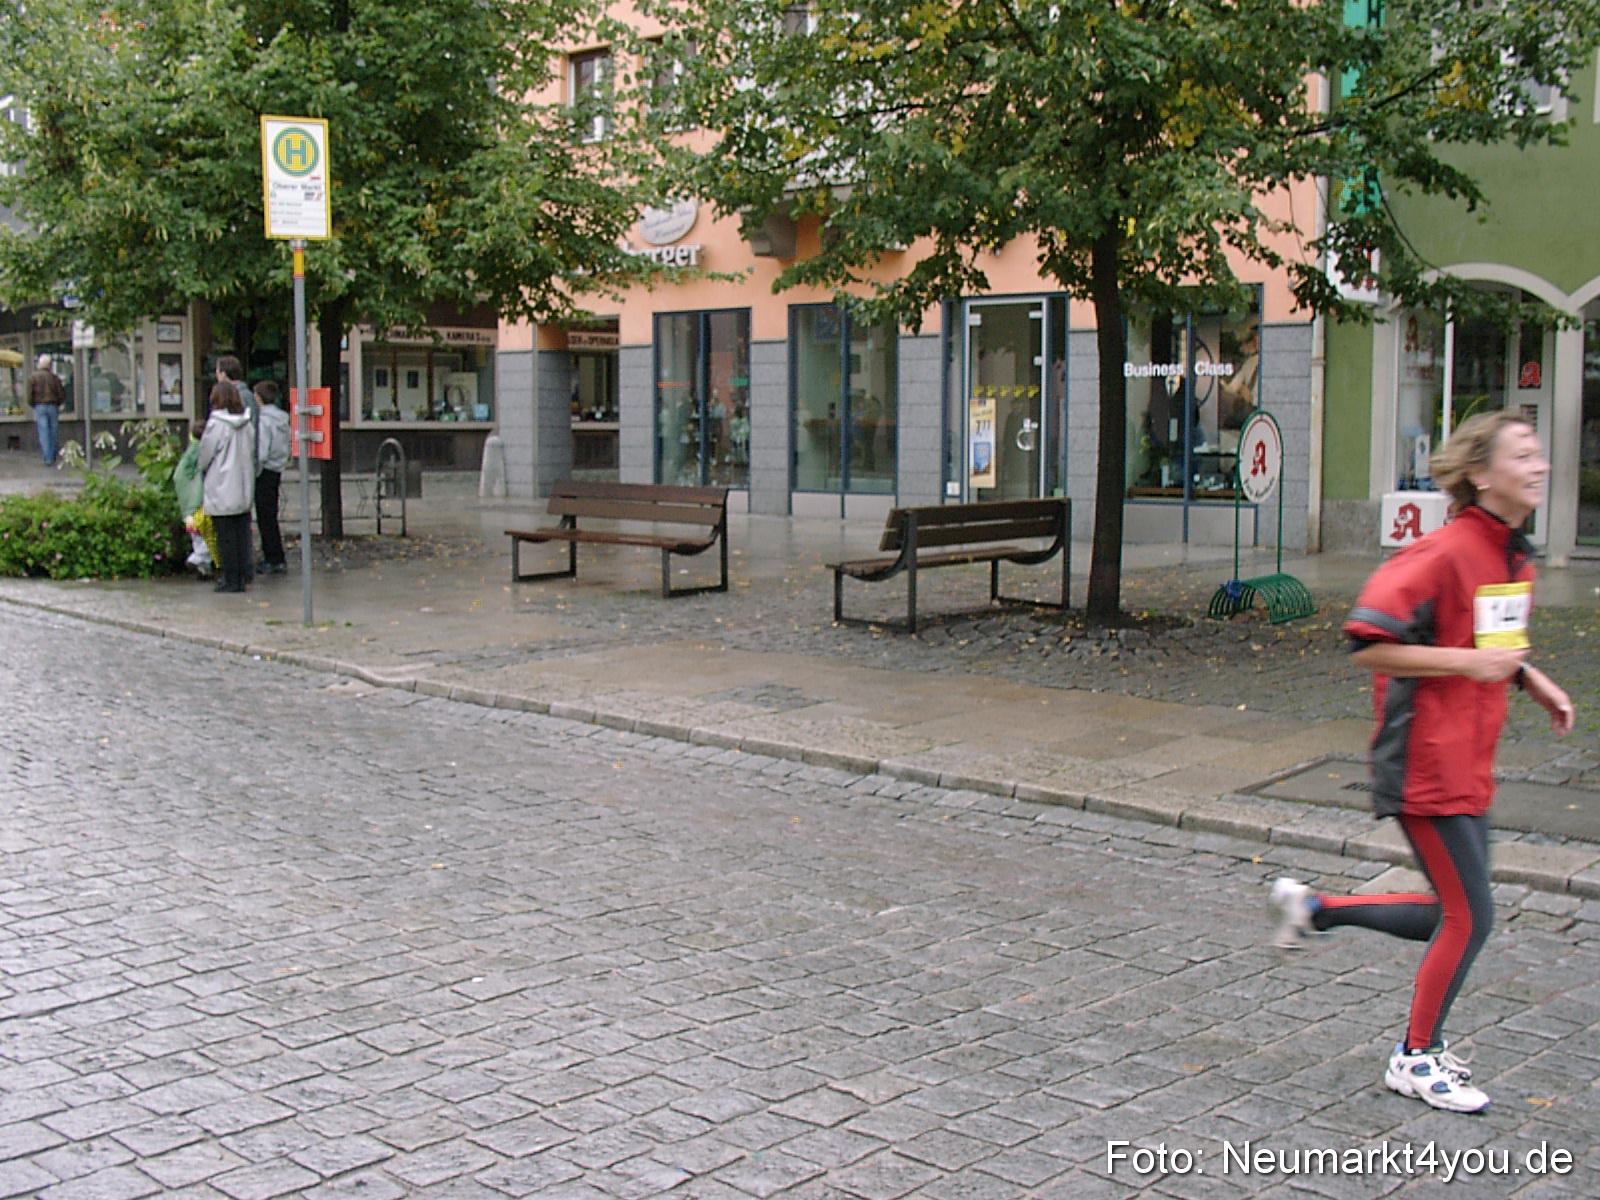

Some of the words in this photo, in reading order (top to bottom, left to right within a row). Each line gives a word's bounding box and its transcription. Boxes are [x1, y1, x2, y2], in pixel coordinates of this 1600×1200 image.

[285, 138, 307, 166] H
[1123, 360, 1184, 377] Business
[1194, 360, 1234, 376] Class
